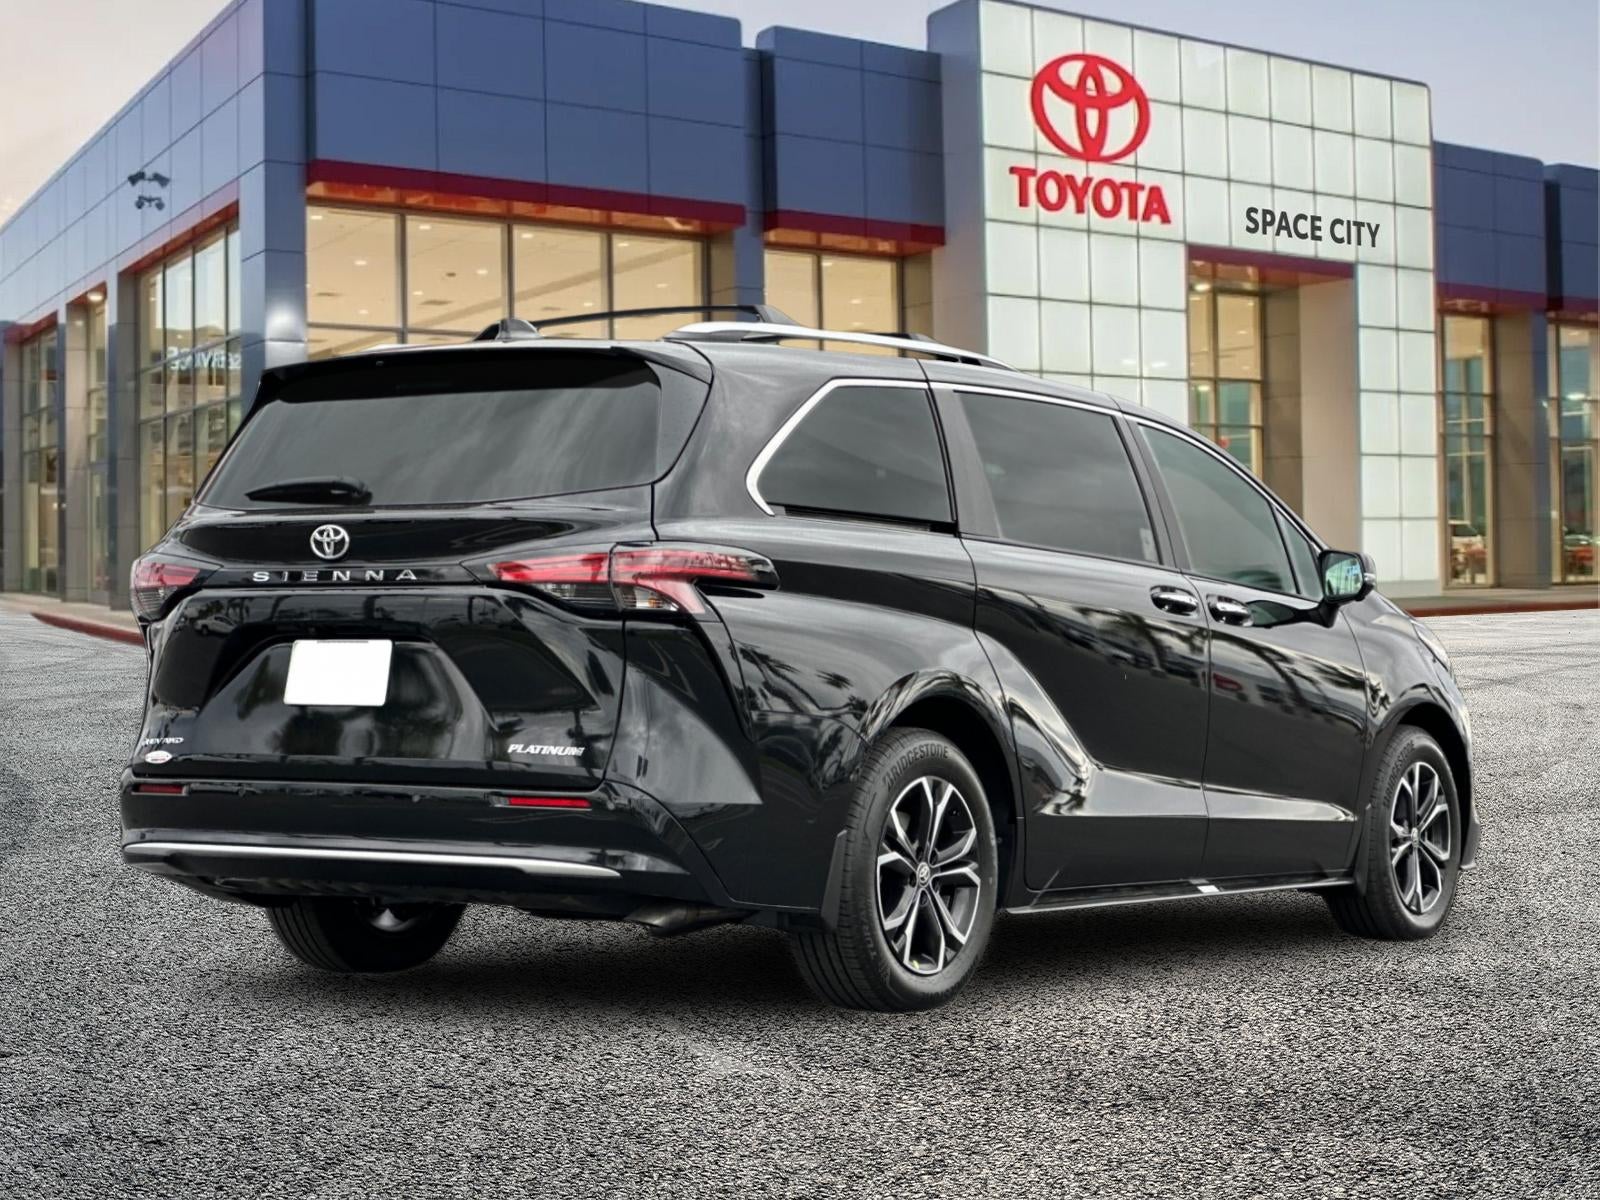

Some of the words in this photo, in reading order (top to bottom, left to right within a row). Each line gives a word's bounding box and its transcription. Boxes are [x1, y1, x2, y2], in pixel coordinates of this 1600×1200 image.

[1009, 166, 1171, 224] TOYOTA
[1245, 207, 1322, 241] SPACE
[1329, 218, 1380, 247] CITY
[252, 568, 418, 582] SIENNA
[507, 743, 585, 757] PLATINUM
[882, 742, 949, 791] BRIDGESTONE
